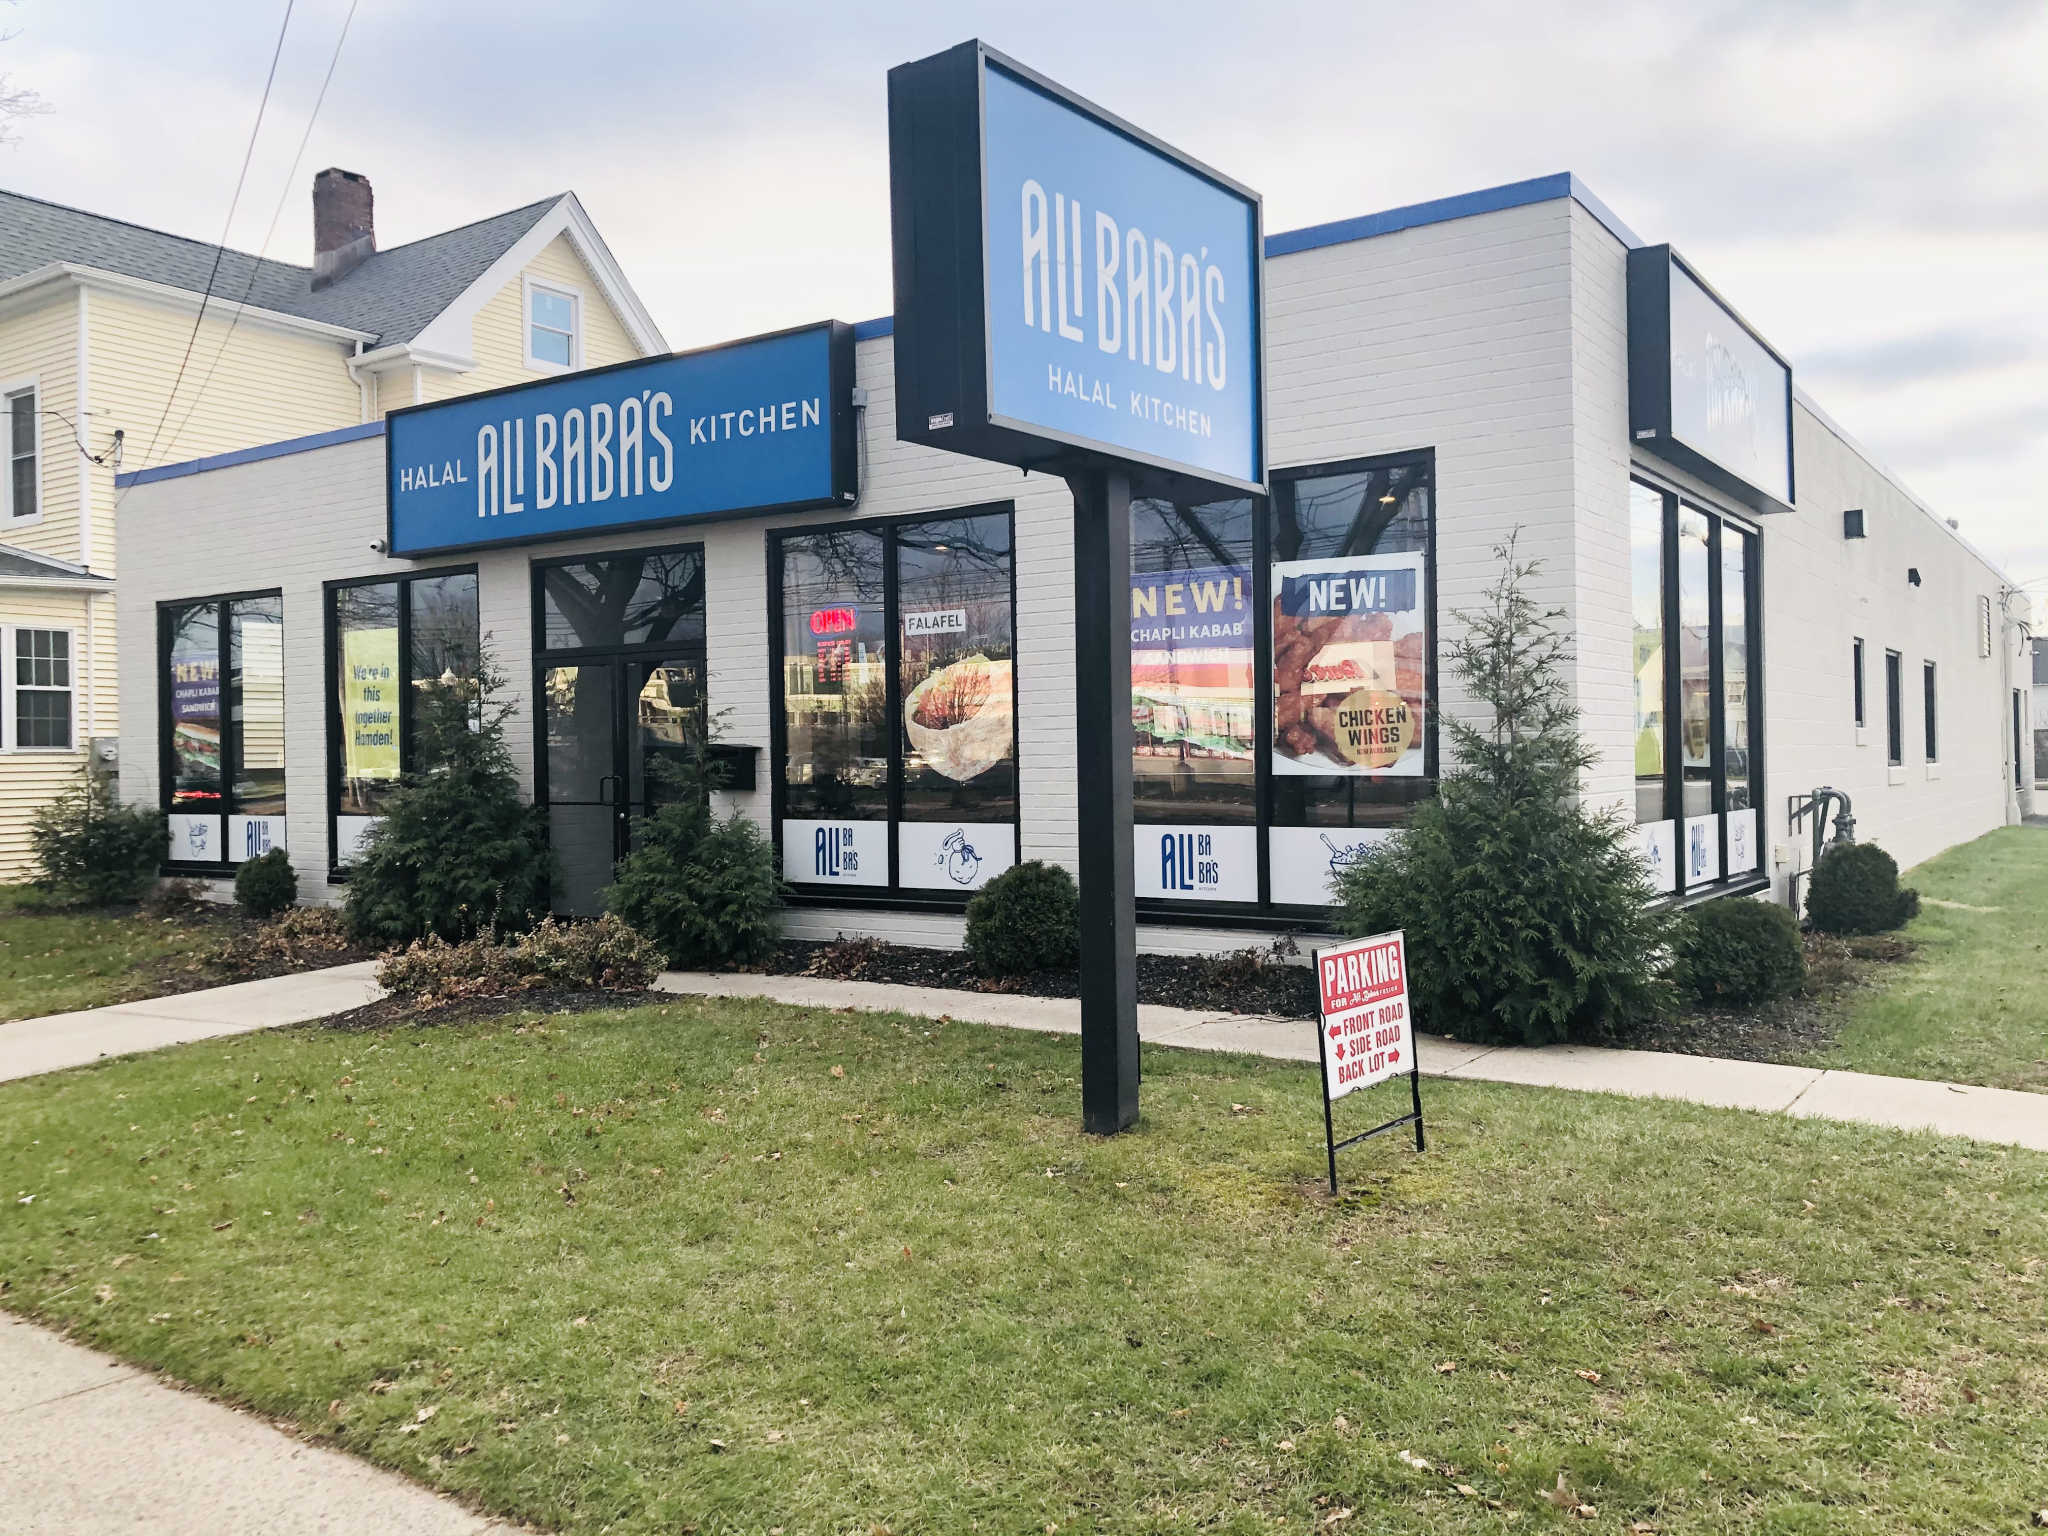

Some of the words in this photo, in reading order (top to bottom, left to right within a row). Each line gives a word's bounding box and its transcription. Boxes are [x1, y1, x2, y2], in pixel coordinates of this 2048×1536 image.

[1021, 179, 1084, 343] ALI
[1095, 210, 1226, 391] BABA'S
[1048, 364, 1117, 409] HALAL
[1130, 390, 1212, 438] KITCHEN
[400, 459, 468, 492] HALAL
[477, 418, 525, 518] ALI
[536, 389, 674, 509] BABA'S
[690, 397, 820, 445] KITCHEN
[1132, 577, 1243, 618] NEW!
[1308, 576, 1387, 612] NEW!
[810, 609, 856, 634] OPEN
[908, 613, 963, 631] FALAFEL
[1130, 626, 1185, 642] CHAPLI
[1189, 622, 1243, 638] KABAB
[1146, 648, 1229, 664] SANDWICH
[353, 664, 378, 681] We're
[381, 663, 390, 679] in
[363, 685, 381, 702] this
[355, 708, 392, 728] together
[1339, 706, 1407, 728] CHICKEN
[355, 729, 393, 746] Hamden!
[1348, 727, 1400, 746] WINGS
[1357, 747, 1369, 755] NOW
[1370, 746, 1397, 755] AVAILABLE
[815, 827, 840, 876] ALI
[843, 827, 853, 846] BA
[1161, 833, 1194, 890] ALI
[1198, 834, 1211, 856] BA
[1198, 859, 1218, 884] BA'S
[1324, 944, 1399, 998] PARKING
[1330, 997, 1347, 1009] FOR
[1379, 985, 1398, 995] FUSION
[1343, 1010, 1375, 1037] FRONT
[1379, 1002, 1404, 1026] ROAD
[1349, 1035, 1372, 1058] SIDE
[1375, 1024, 1401, 1048] ROAD
[1338, 1058, 1365, 1085] BACK
[1368, 1051, 1385, 1074] LOT
